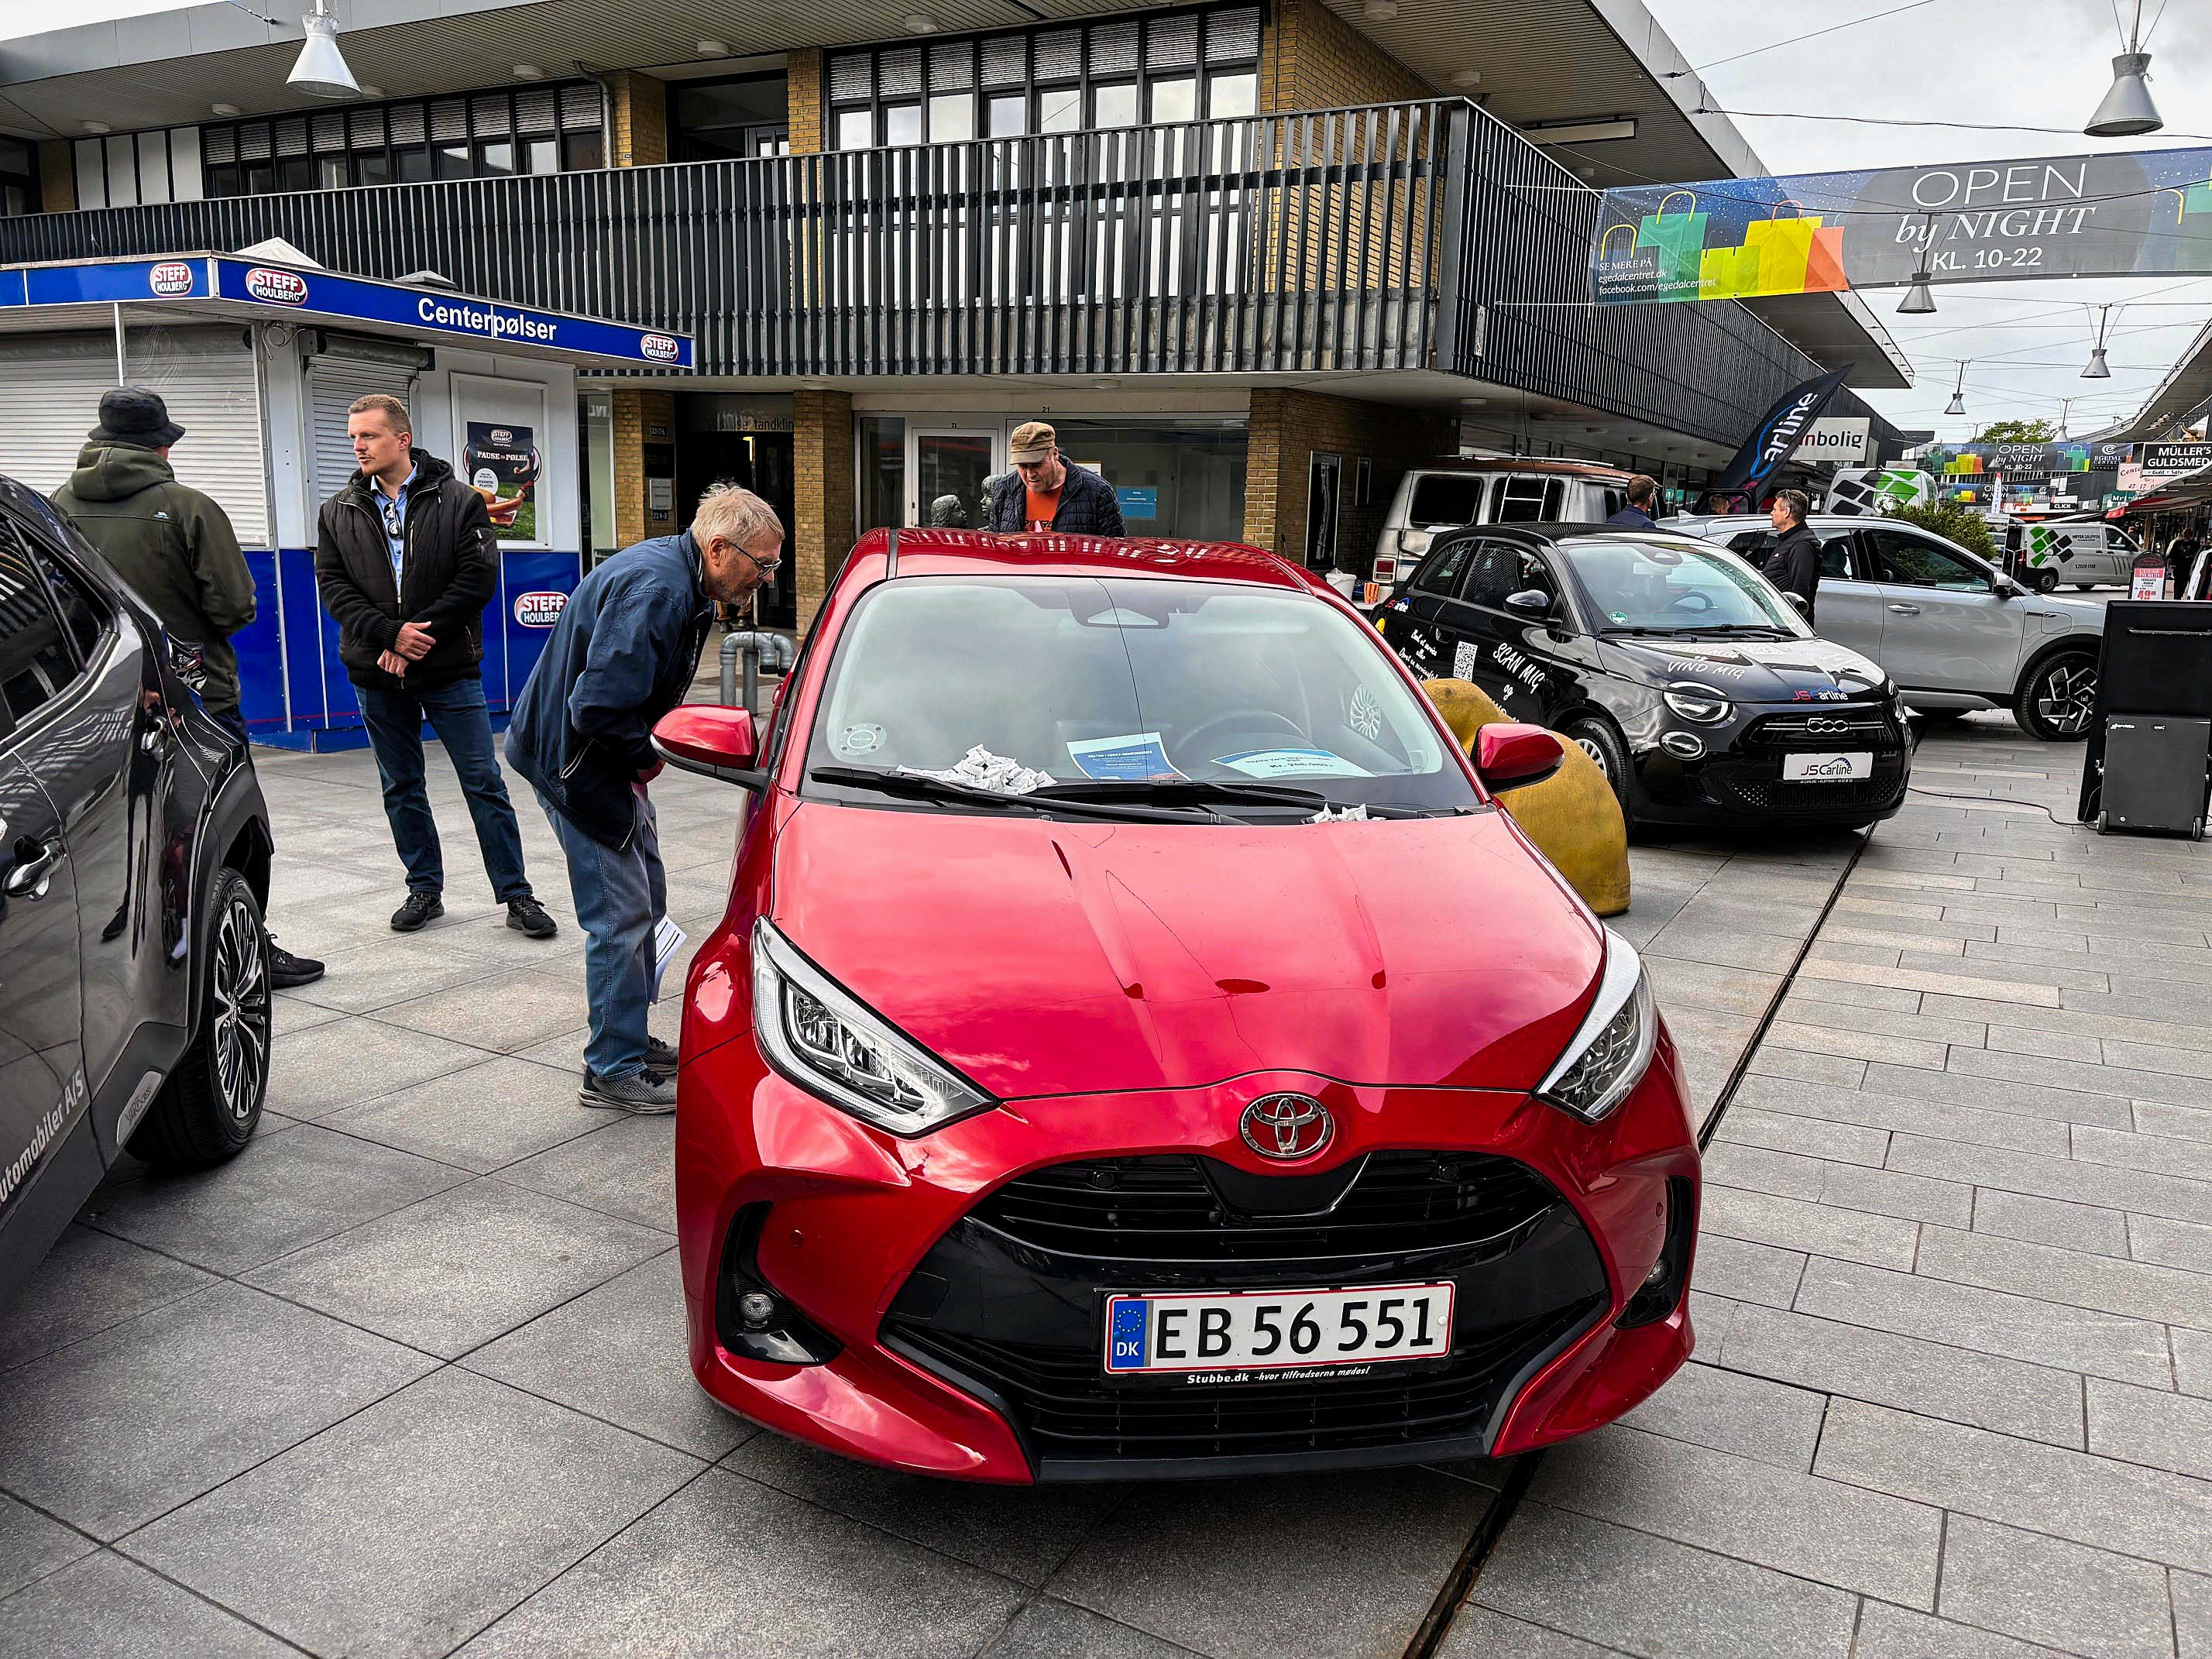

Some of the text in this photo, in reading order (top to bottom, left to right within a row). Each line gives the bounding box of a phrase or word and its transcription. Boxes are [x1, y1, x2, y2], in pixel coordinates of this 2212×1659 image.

[1911, 163, 2087, 207] OPEN
[1894, 207, 2097, 253] by NIGHT
[1599, 257, 1653, 271] SE MERE PÅ
[1932, 246, 2043, 271] KL. 10-22
[154, 266, 186, 282] STEFF
[255, 271, 299, 292] STEFF
[1598, 269, 1667, 284] egedalcentret.dk
[156, 281, 188, 293] HOULBERG
[256, 286, 301, 302] HOULBERG
[1599, 278, 1717, 296] facebook.com/egedalcentret
[417, 297, 557, 341] Centerpølser
[647, 336, 673, 350] STEFF
[647, 348, 674, 359] HOULBERG
[477, 451, 500, 460] PAUSE
[505, 453, 528, 462] PØLSE
[1998, 445, 2042, 455] OPEN
[2158, 445, 2212, 456] MÜLLER'S
[1995, 454, 2045, 464] by NIGHT
[523, 596, 564, 612] STEFF
[1493, 643, 1545, 694] SCAN MIG
[1668, 661, 1746, 680] VIND MIG
[1503, 684, 1513, 701] og
[1807, 718, 1849, 733] 500
[0, 1070, 84, 1202] utomobiler A/S
[1116, 1297, 1434, 1359] DK EB 56 551
[1187, 1373, 1249, 1384] Stubbe.dk
